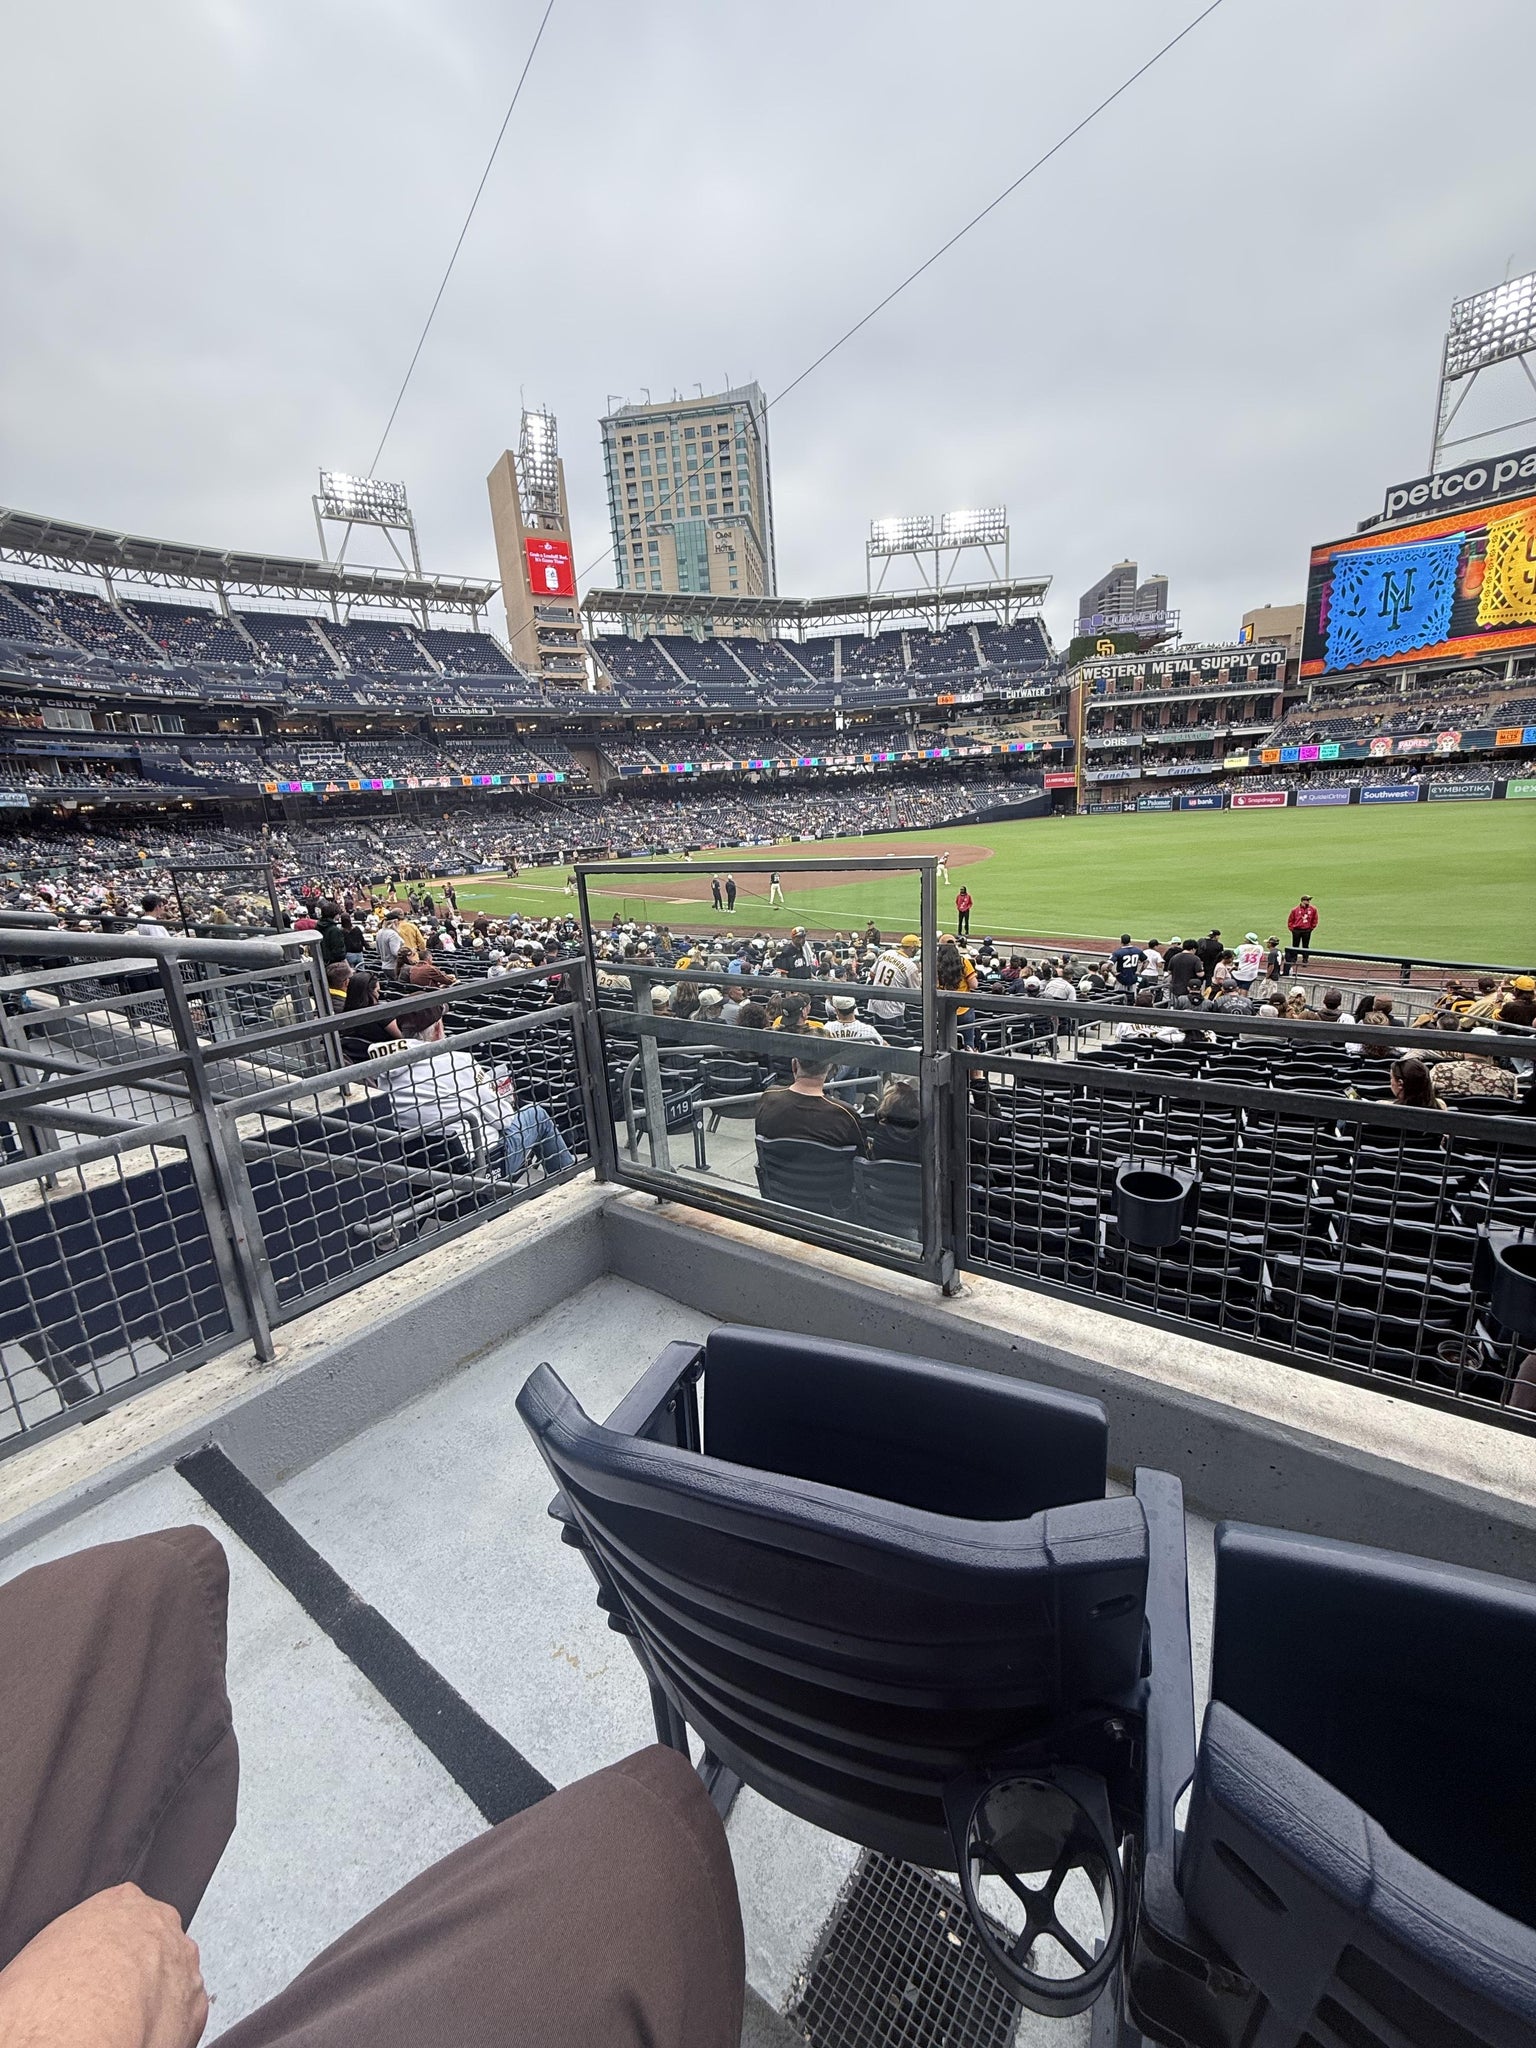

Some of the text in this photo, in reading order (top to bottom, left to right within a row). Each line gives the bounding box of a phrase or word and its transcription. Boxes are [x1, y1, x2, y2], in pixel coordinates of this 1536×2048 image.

[1385, 468, 1488, 519] petco
[1082, 663, 1146, 681] WESTERN
[1151, 658, 1198, 675] METAL
[1200, 653, 1256, 671] SUPPLY
[1260, 651, 1285, 665] CO.
[1006, 687, 1045, 699] CUTWATER
[46, 699, 97, 710] CENTER
[1103, 737, 1128, 747] ORIS
[1363, 790, 1409, 800] Southwest
[1431, 785, 1491, 794] CYMBIOTIKA
[1197, 797, 1214, 806] bank
[1247, 796, 1281, 804] Snapdragon
[1123, 803, 1136, 812] 342
[1122, 953, 1140, 968] 20
[878, 965, 895, 987] 13
[670, 1100, 689, 1118] 119
